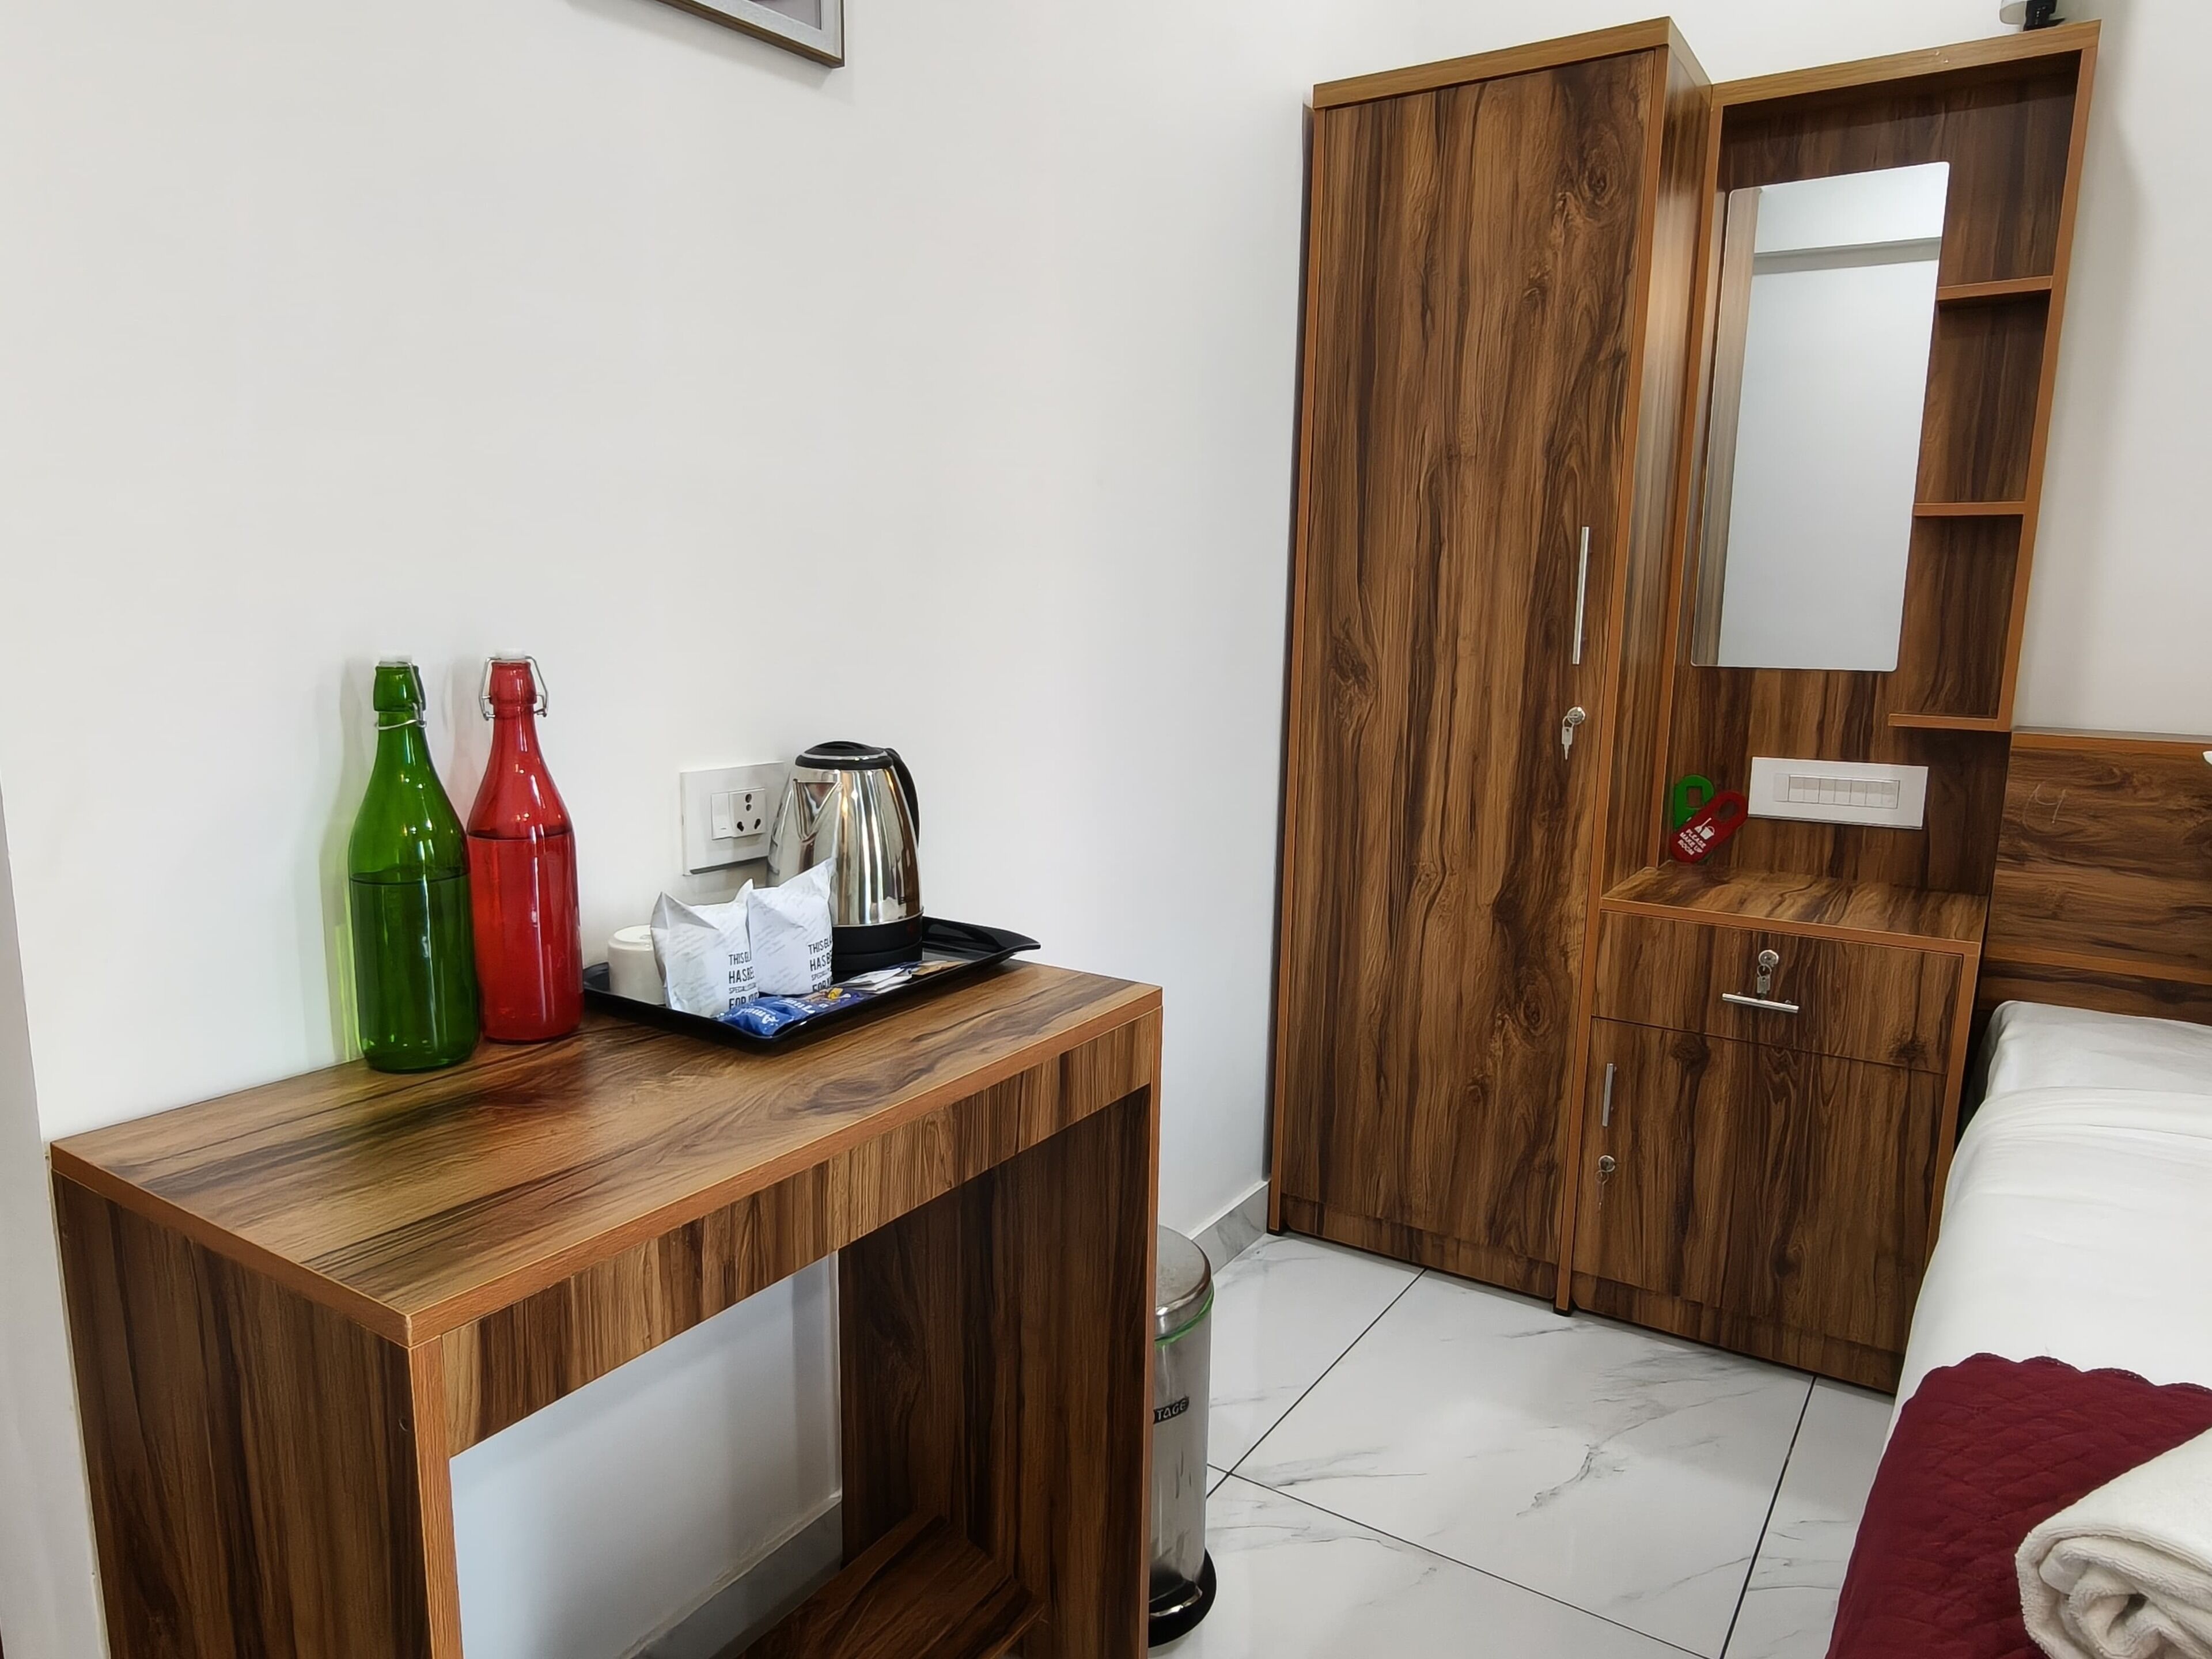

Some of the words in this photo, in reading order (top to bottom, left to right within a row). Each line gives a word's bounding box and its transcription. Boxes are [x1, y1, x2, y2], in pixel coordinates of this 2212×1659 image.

[1679, 832, 1695, 847] MAKE
[1685, 828, 1706, 849] PLEASE
[1677, 839, 1695, 855] ROOM
[808, 940, 824, 955] THIS
[728, 952, 744, 965] THIS
[810, 955, 826, 971] HAS
[729, 969, 747, 984] HAS
[1157, 1399, 1187, 1421] TAGE
